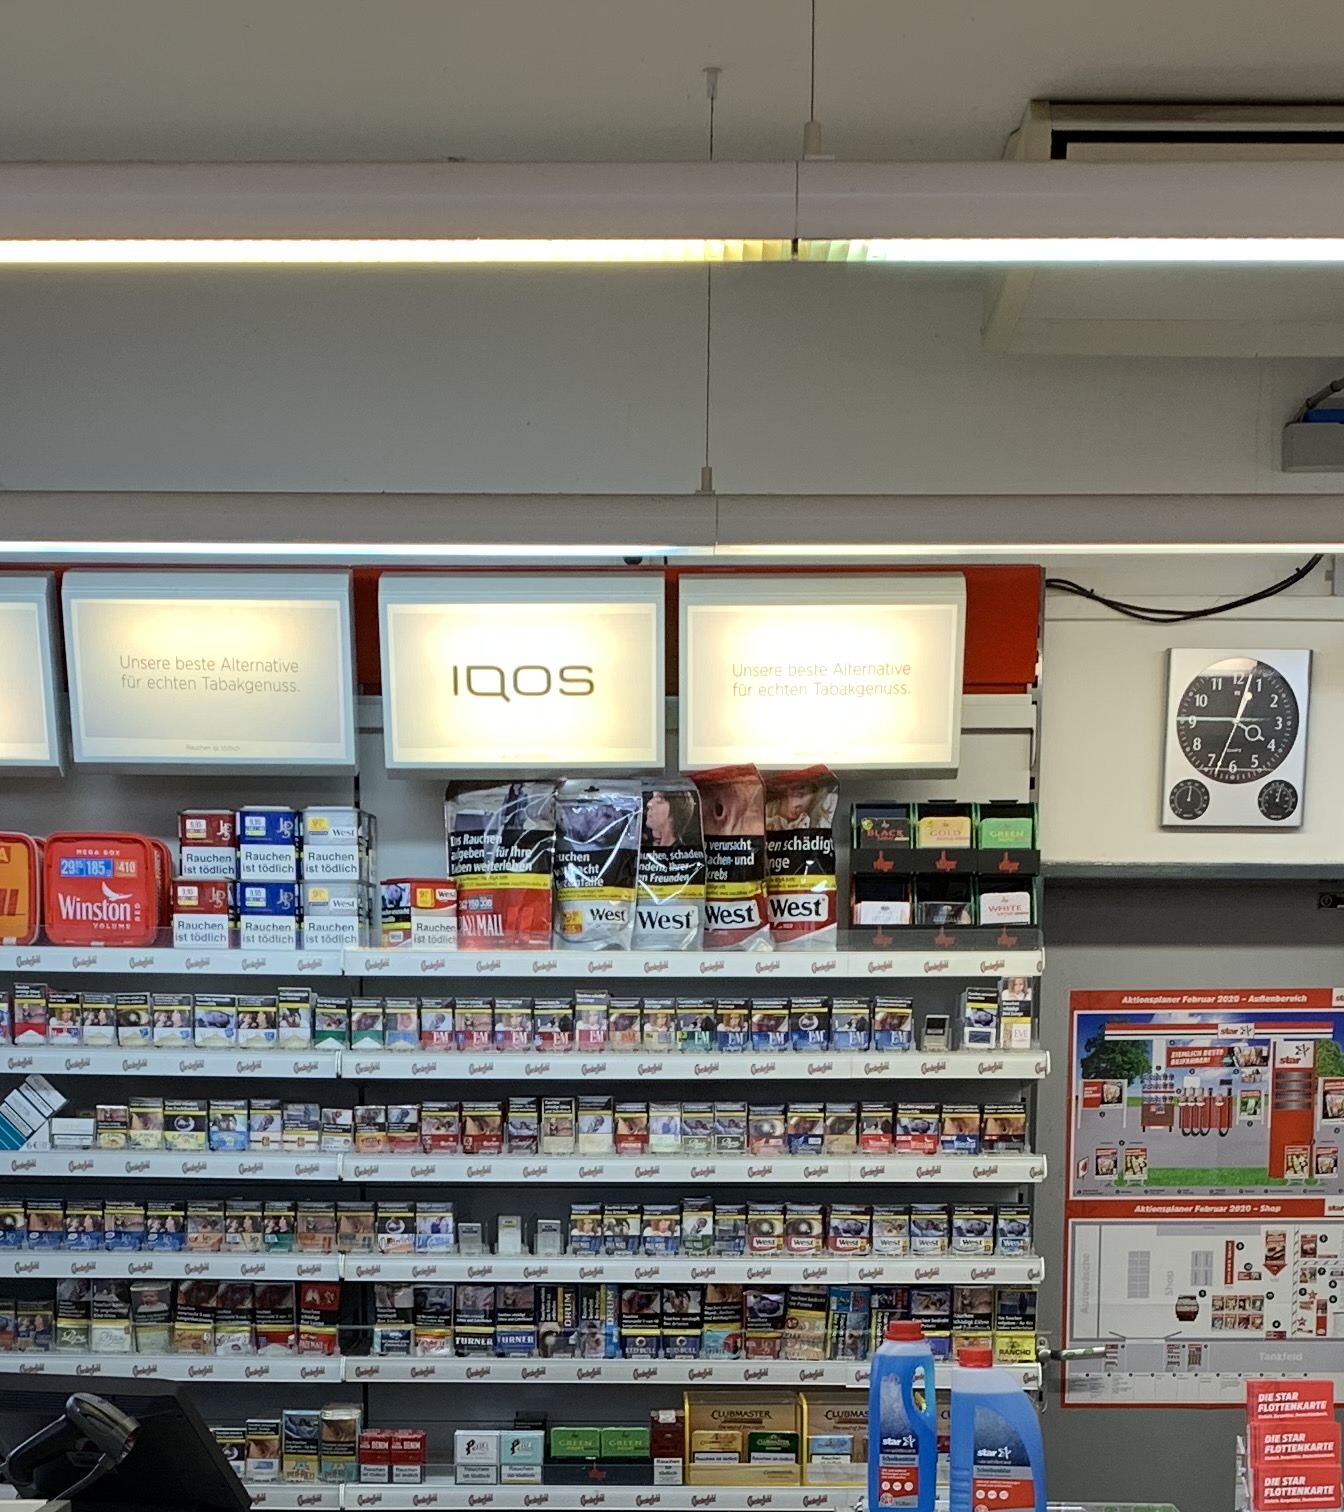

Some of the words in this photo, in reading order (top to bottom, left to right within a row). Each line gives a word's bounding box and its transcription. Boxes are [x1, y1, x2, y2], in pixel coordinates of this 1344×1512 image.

[120, 656, 170, 670] Unsere
[176, 657, 215, 671] beste
[221, 658, 299, 672] Alternative
[122, 675, 142, 688] für
[147, 676, 196, 690] echten
[202, 676, 300, 693] Tabakgenuss.
[453, 663, 595, 704] IQOS
[58, 894, 131, 921] Winston
[770, 896, 823, 917] West
[638, 910, 692, 929] West
[1122, 995, 1182, 1005] Aktionsplaner
[1184, 994, 1215, 1004] Februar
[1217, 994, 1239, 1003] 2020
[1134, 1205, 1193, 1214] Aktionsplaner
[1195, 1205, 1227, 1214] Februar
[1229, 1204, 1251, 1214] 2020
[1259, 1204, 1281, 1214] Shop
[1259, 1351, 1303, 1362] Tankfeld
[1258, 1393, 1273, 1402] DIE
[1276, 1392, 1298, 1401] STAR
[1258, 1401, 1327, 1412] FLOTTENKARTE
[711, 1409, 772, 1420] CLUBMASTER
[1265, 1434, 1280, 1443] DIE
[1282, 1433, 1305, 1442] STAR
[1265, 1442, 1334, 1453] FLOTTENKARTE
[1264, 1478, 1280, 1486] DIE
[1282, 1477, 1305, 1485] STAR
[1264, 1486, 1334, 1496] FLOTTENKARTE
